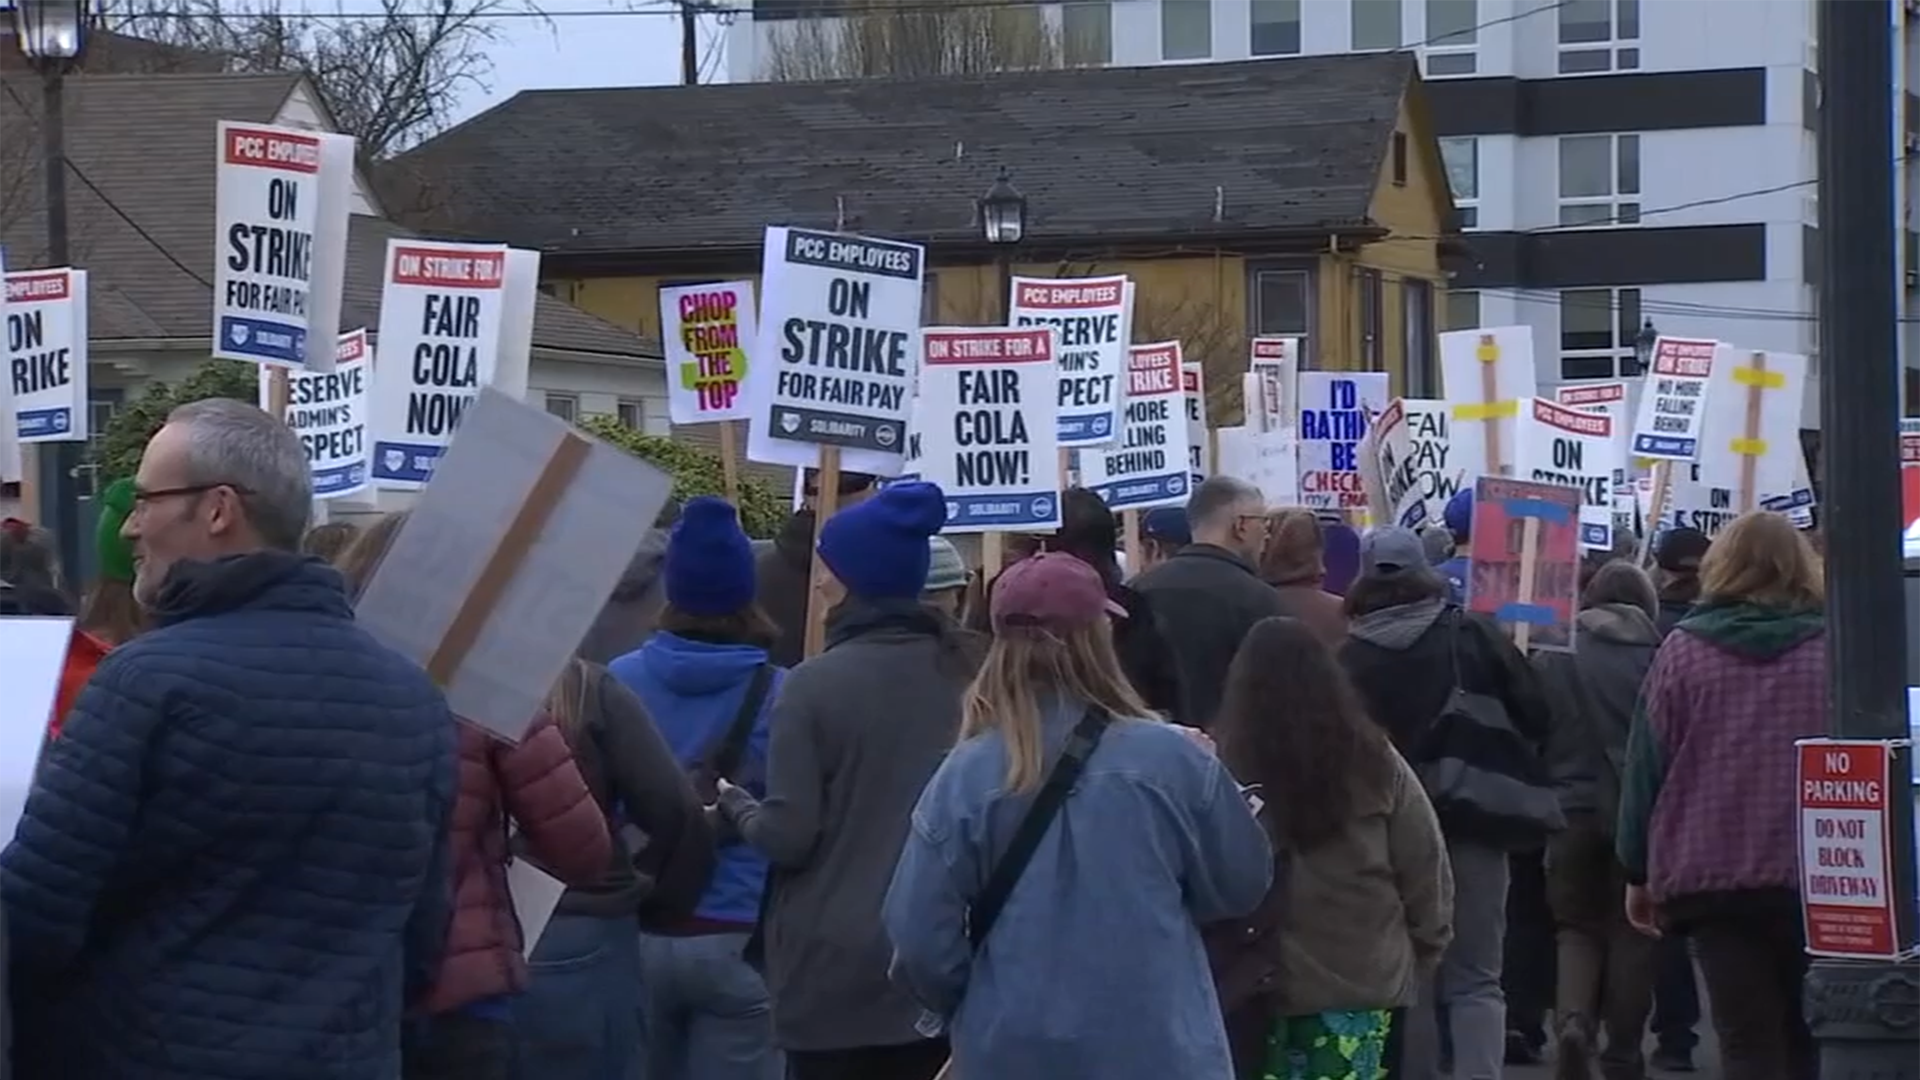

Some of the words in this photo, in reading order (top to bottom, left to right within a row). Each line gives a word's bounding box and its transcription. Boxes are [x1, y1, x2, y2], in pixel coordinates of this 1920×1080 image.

[235, 136, 264, 159] PCC
[269, 178, 298, 220] ON
[228, 222, 312, 281] STRIKE
[795, 237, 825, 259] PCC
[829, 242, 911, 271] EMPLOYEES
[399, 255, 421, 277] ON
[423, 257, 472, 279] STRIKE
[474, 259, 494, 280] FOR
[226, 280, 261, 311] FOR
[263, 284, 291, 314] FAIR
[679, 291, 737, 323] CHOP
[828, 277, 870, 319] ON
[1024, 287, 1048, 303] PCC
[1051, 287, 1117, 304] EMPLOYEES
[423, 294, 480, 338] FAIR
[8, 310, 42, 352] ON
[683, 323, 738, 352] FROM
[782, 317, 908, 377] STRIKE
[929, 340, 949, 357] ON
[952, 340, 1001, 358] STRIKE
[1004, 338, 1032, 356] FOR
[1035, 338, 1047, 354] A
[1058, 351, 1099, 371] MIN'S
[1129, 352, 1172, 369] LOYEES
[12, 348, 70, 396] RIKE
[413, 342, 477, 387] COLA
[695, 350, 733, 377] THE
[1676, 357, 1711, 375] STRIKE
[288, 367, 363, 404] ESERVE
[694, 379, 738, 411] TOP
[778, 371, 817, 400] FOR
[820, 376, 864, 406] FAIR
[868, 381, 905, 411] PAY
[958, 369, 1020, 405] FAIR
[1058, 374, 1115, 407] PECT
[1331, 380, 1356, 409] I'D
[1657, 380, 1673, 395] NO
[1674, 381, 1702, 397] MORE
[288, 404, 351, 428] ADMIN'S
[406, 392, 475, 435] NOW
[1536, 402, 1553, 421] PCC
[1553, 408, 1606, 432] EMPLOYEES
[1655, 397, 1696, 415] FALLING
[809, 418, 867, 438] SOLIDARITY
[955, 410, 1029, 446] COLA
[1653, 415, 1690, 433] BEHIND
[301, 424, 364, 462] SPECT
[1331, 442, 1357, 471] BE
[1553, 438, 1583, 470] ON
[956, 451, 1030, 487] NOW!
[1105, 450, 1166, 477] BEHIND
[1418, 468, 1466, 500] OW
[1711, 488, 1731, 508] ON
[968, 502, 1022, 516] SOLIDARITY
[1825, 752, 1850, 773] NO
[1804, 780, 1880, 802] PARKING
[1815, 818, 1834, 838] DO
[1835, 819, 1866, 839] NOT
[1818, 847, 1865, 868] BLOCK
[1810, 875, 1878, 898] DRIVEWAY
